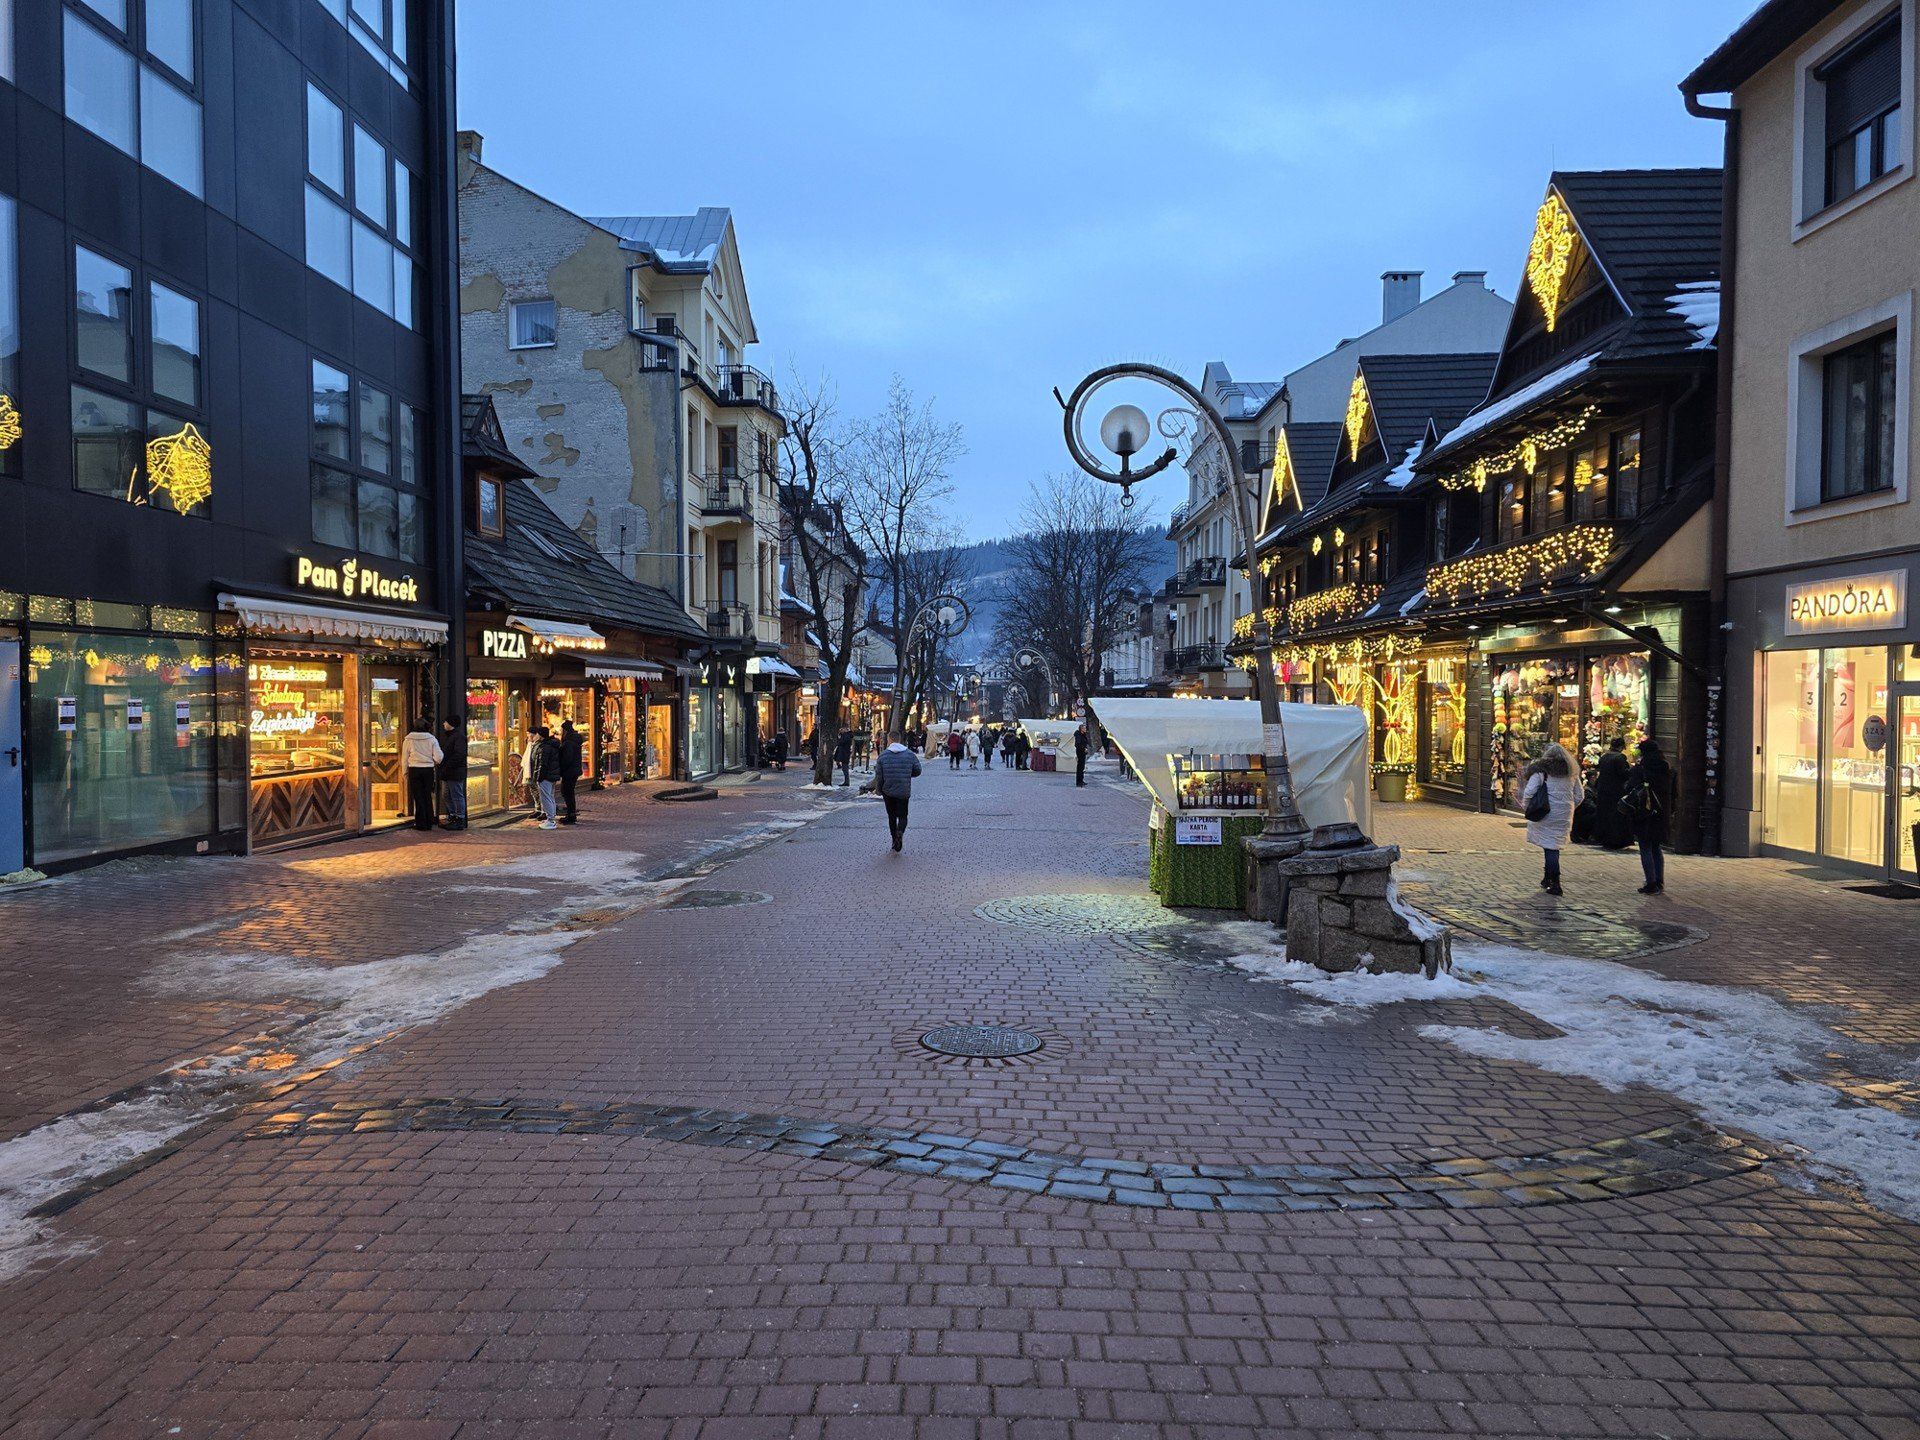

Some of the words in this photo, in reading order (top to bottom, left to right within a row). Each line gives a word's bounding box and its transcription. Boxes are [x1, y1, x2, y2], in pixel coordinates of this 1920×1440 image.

[298, 557, 337, 590] Pan
[361, 568, 418, 602] Placek
[1791, 587, 1888, 620] PANDORA
[483, 629, 527, 659] PIZZA
[1806, 691, 1814, 706] 3
[1840, 691, 1848, 706] 2
